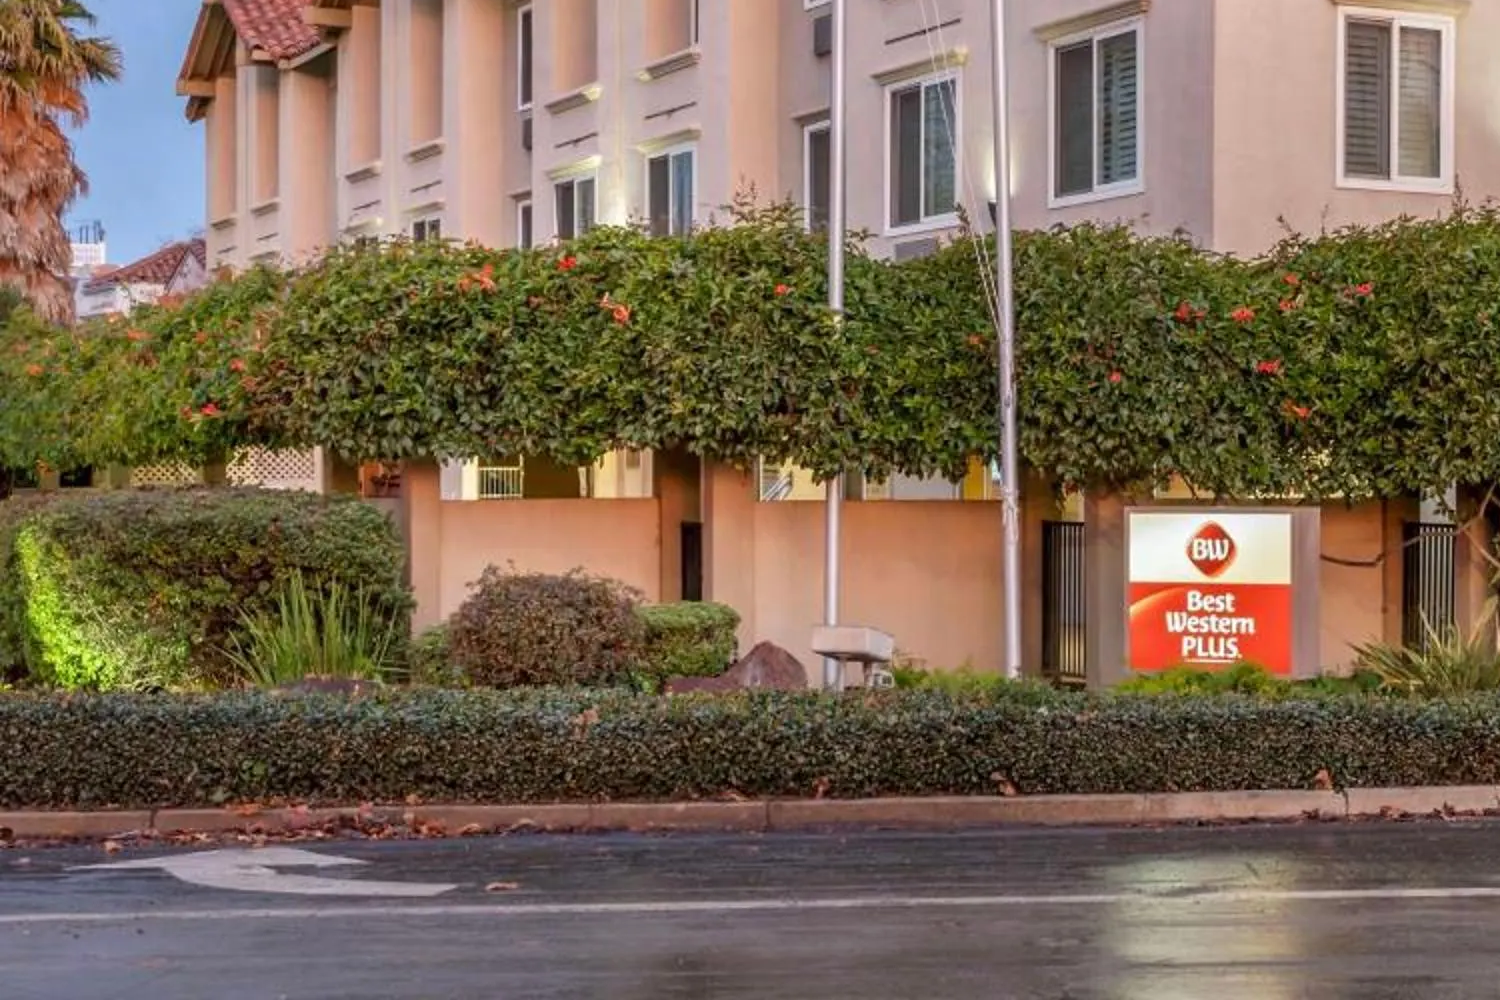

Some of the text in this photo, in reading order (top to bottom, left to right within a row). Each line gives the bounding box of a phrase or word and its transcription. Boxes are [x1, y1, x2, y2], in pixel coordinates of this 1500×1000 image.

[1192, 538, 1229, 560] BW
[1187, 590, 1235, 612] Best
[1165, 611, 1255, 634] Western
